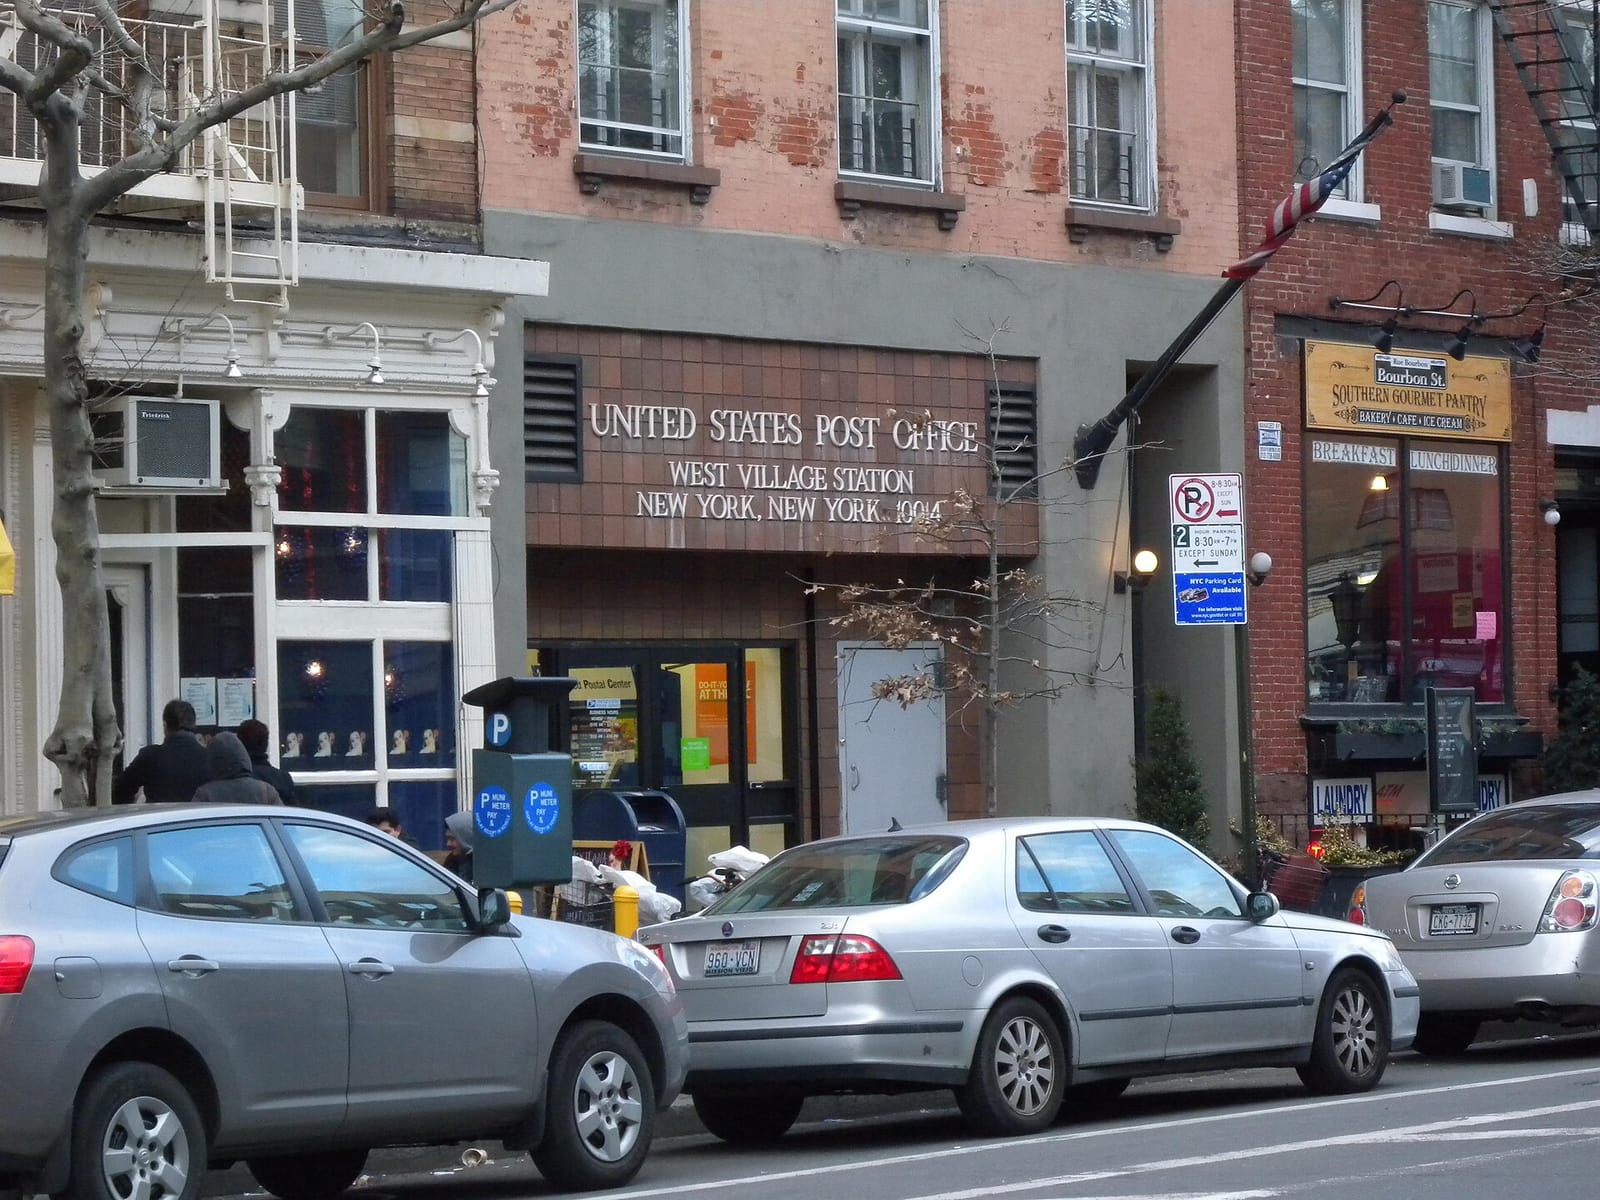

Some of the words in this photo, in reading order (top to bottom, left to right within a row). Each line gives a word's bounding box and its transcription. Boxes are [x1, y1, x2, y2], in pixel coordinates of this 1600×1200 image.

[1404, 359, 1429, 368] Bourbon
[1377, 368, 1428, 386] Bourbon
[1430, 373, 1446, 387] St.
[1332, 384, 1390, 407] SOUTHERN
[1392, 389, 1444, 407] GOURMET
[1445, 393, 1488, 419] PANTRY
[588, 403, 697, 440] UNITED
[709, 409, 803, 445] STATES
[815, 414, 881, 449] POST
[892, 418, 979, 453] OFFICE
[1359, 410, 1392, 424] BAKERY
[1397, 414, 1417, 425] CAFE
[1423, 416, 1435, 427] ICE
[1436, 417, 1463, 429] CREAM
[1313, 441, 1395, 466] BREAKFAST
[1410, 451, 1450, 470] LUNCH
[1452, 454, 1497, 473] DINNER
[668, 461, 729, 488] WEST
[736, 464, 828, 491] VILLAGE
[833, 466, 914, 494] STATION
[636, 491, 688, 518] NEW
[695, 493, 762, 522] YORK,
[768, 495, 817, 521] NEW
[824, 497, 881, 524] YORK
[1176, 526, 1187, 546] 2
[1179, 549, 1206, 558] EXCEPT
[1210, 549, 1238, 558] SUNDAY
[1204, 578, 1227, 586] Parking
[584, 679, 605, 689] Postal
[607, 678, 632, 689] Center
[699, 689, 711, 700] AT
[493, 713, 509, 744] P
[481, 792, 490, 809] P
[491, 802, 510, 810] METER
[530, 790, 539, 807] P
[540, 798, 557, 806] METER
[1316, 784, 1369, 815] LAUNDRY
[486, 811, 498, 819] PAY
[536, 808, 546, 816] PAY
